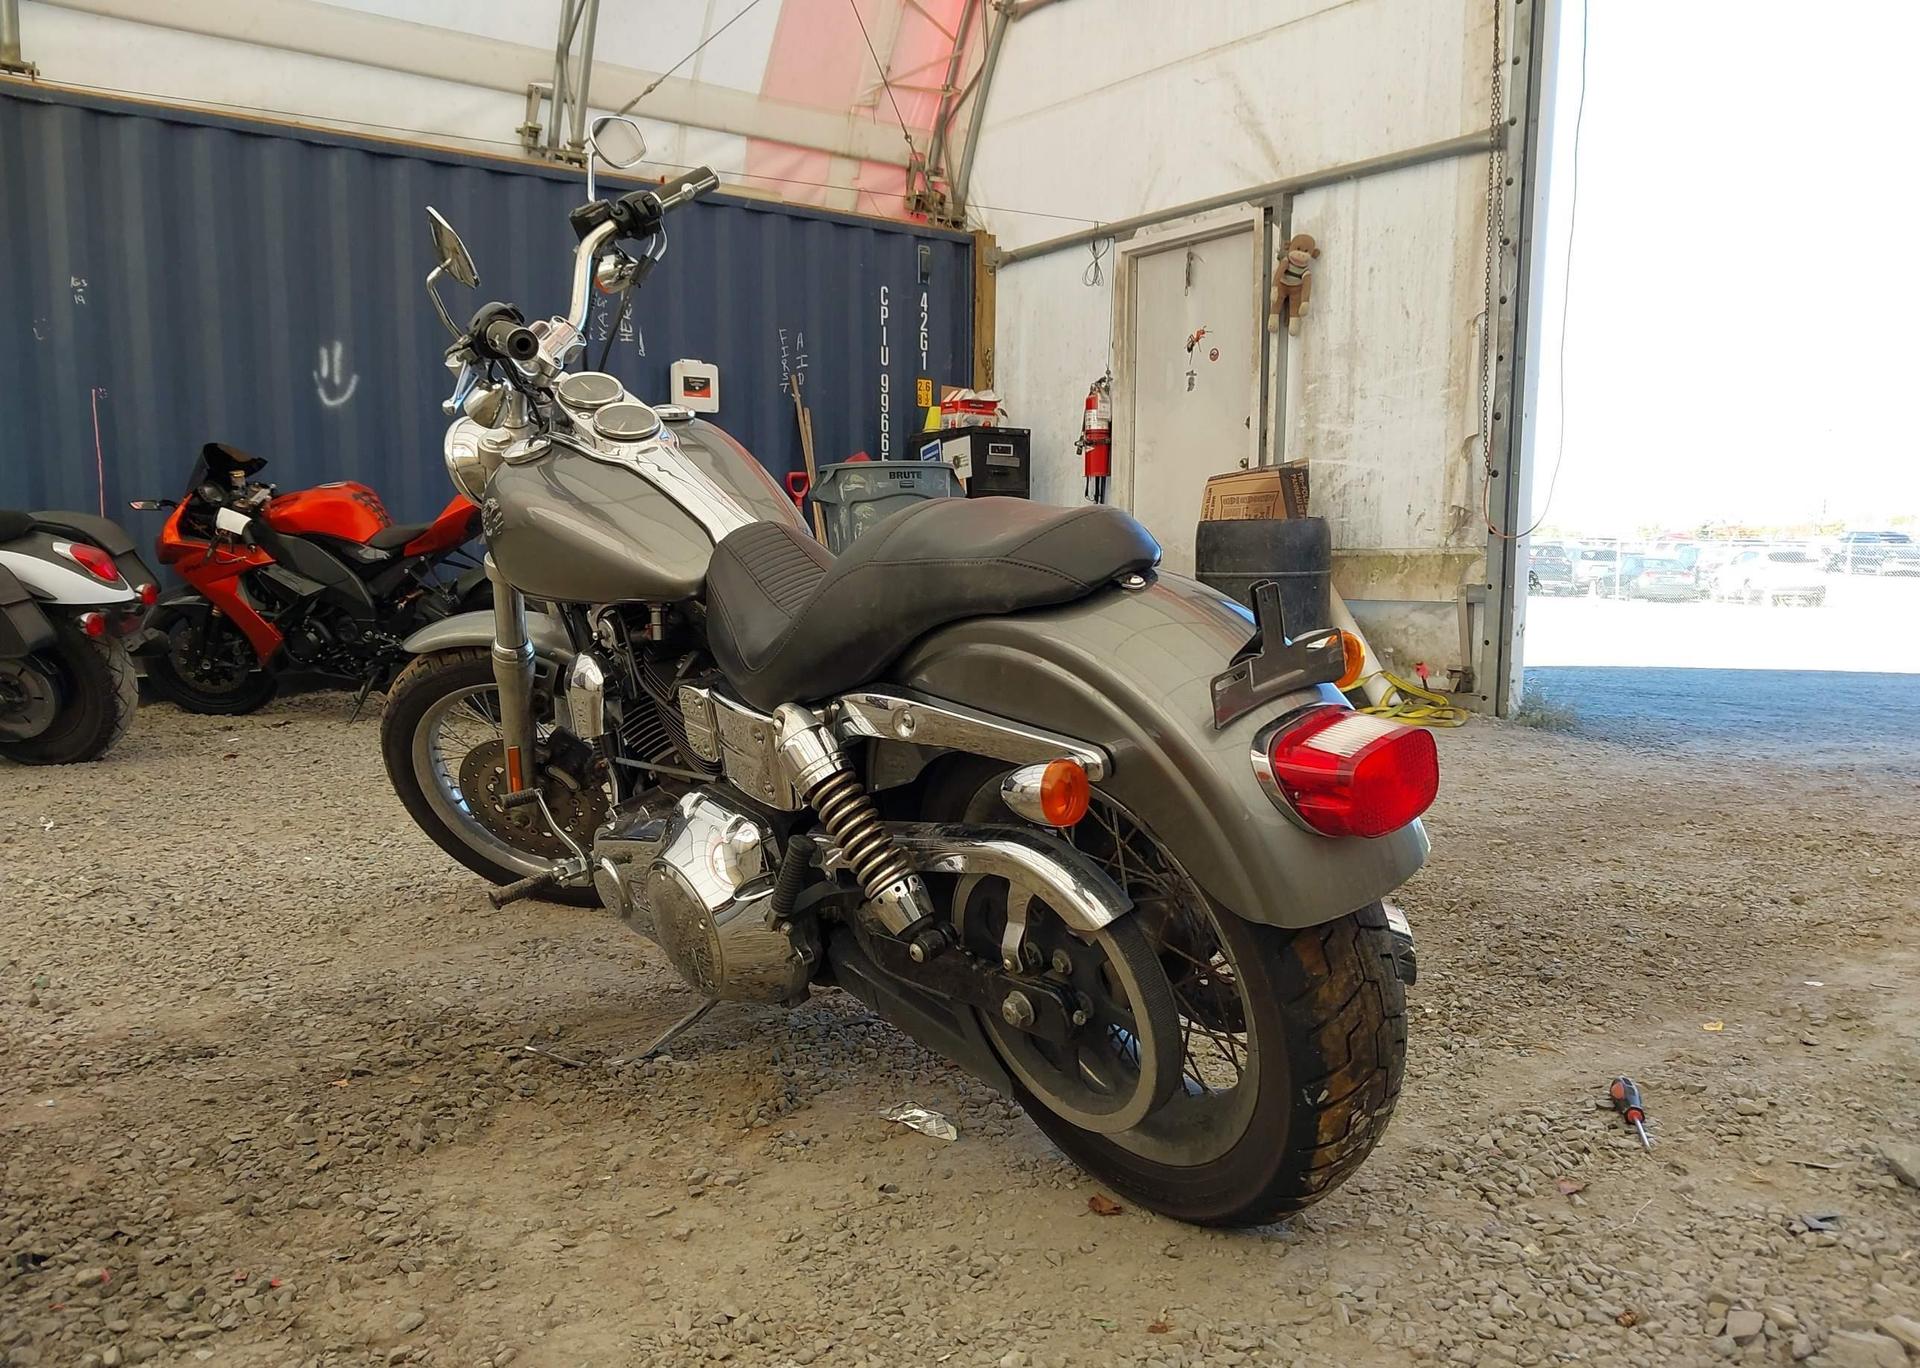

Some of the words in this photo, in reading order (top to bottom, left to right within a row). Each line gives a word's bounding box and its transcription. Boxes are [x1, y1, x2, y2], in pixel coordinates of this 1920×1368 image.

[796, 332, 808, 385] AID
[880, 286, 889, 366] CPIU
[920, 292, 929, 371] 42G1
[779, 328, 790, 393] FIRST
[888, 471, 922, 479] BRUTE
